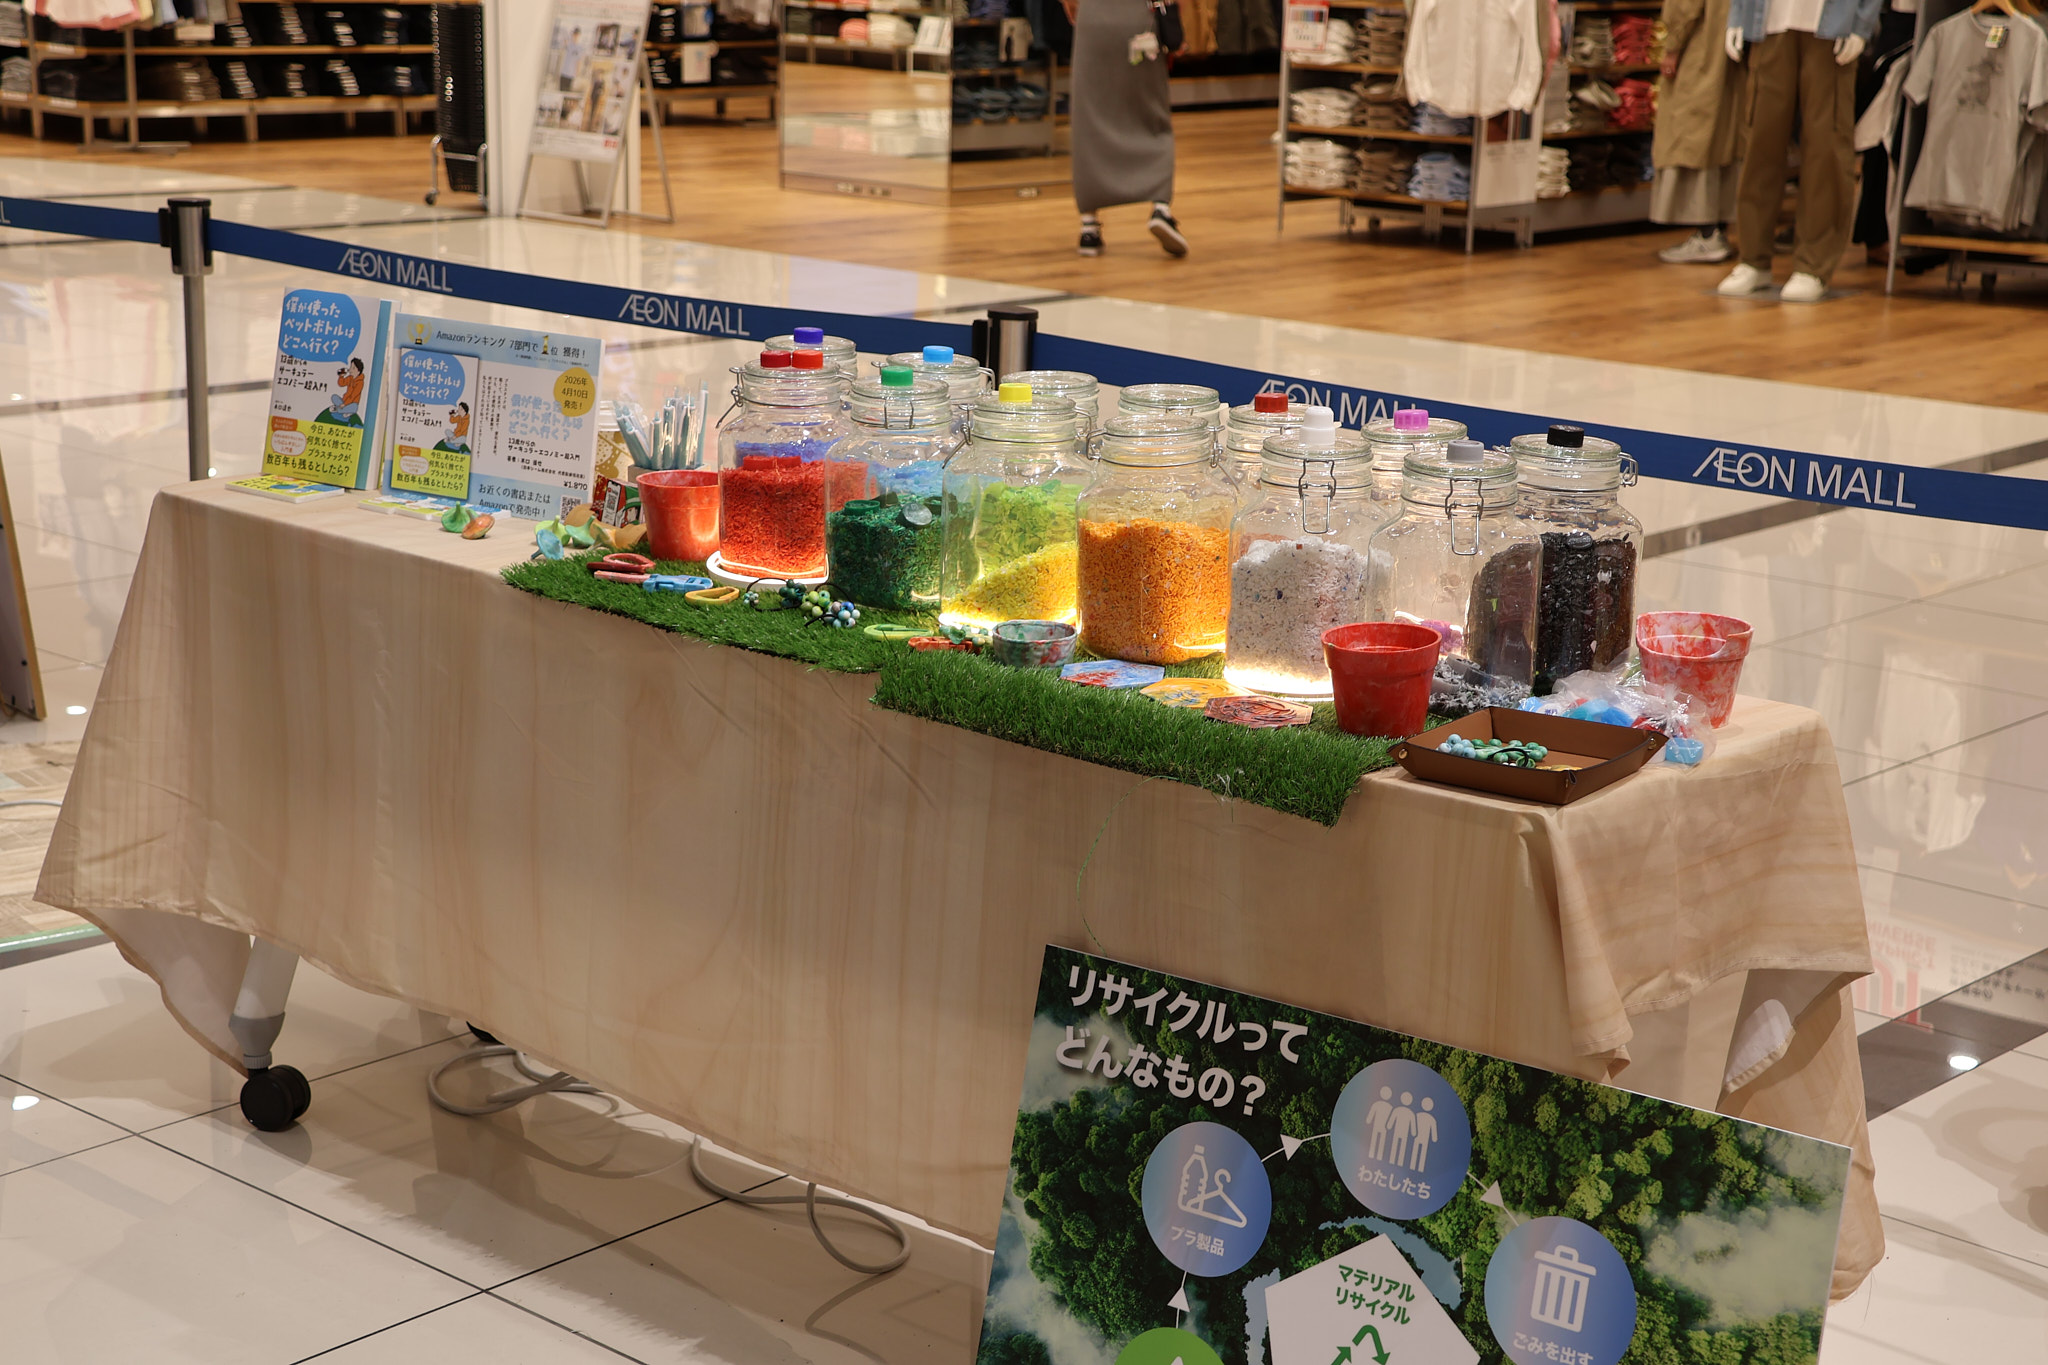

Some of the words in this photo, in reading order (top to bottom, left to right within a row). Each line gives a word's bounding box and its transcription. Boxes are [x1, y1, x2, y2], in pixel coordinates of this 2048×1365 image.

[397, 258, 453, 292] MALL
[286, 296, 341, 318] 僕が使った
[285, 318, 355, 338] ペットボトルは
[686, 302, 750, 336] MALL
[283, 334, 339, 355] どこへ行く？
[436, 330, 506, 348] Amazonランキング
[404, 355, 448, 372] 僕が使った
[404, 371, 461, 388] ペットボトルは
[564, 375, 588, 386] 2026年
[404, 383, 450, 400] どこへ行く？
[561, 388, 588, 399] 4月10日
[564, 400, 583, 410] 発売！
[1340, 392, 1416, 426] MA
[509, 409, 583, 430] ペットボトルは
[310, 424, 355, 438] 今日、あなたが
[509, 421, 570, 441] どこへ行く？
[307, 436, 352, 451] 何気なく捨てた
[266, 454, 350, 477] 数百年も残るとしたら？
[308, 448, 352, 463] プラスチックが、
[431, 452, 466, 462] 今日、あなたが
[397, 473, 463, 491] 数百年も残るとしたら？
[1806, 460, 1916, 509] MALL
[479, 484, 551, 504] お近くの書店または
[479, 499, 546, 517] Amazonで発売中！
[1068, 965, 1308, 1065] リサイクルって
[1055, 1025, 1266, 1117] どんなもの？
[1358, 1165, 1431, 1199] わたしたち
[1170, 1226, 1225, 1257] プラ製品
[1338, 1264, 1415, 1302] マテリアル
[1336, 1287, 1411, 1325] リサイクル
[1513, 1332, 1594, 1365] ごみを出す
